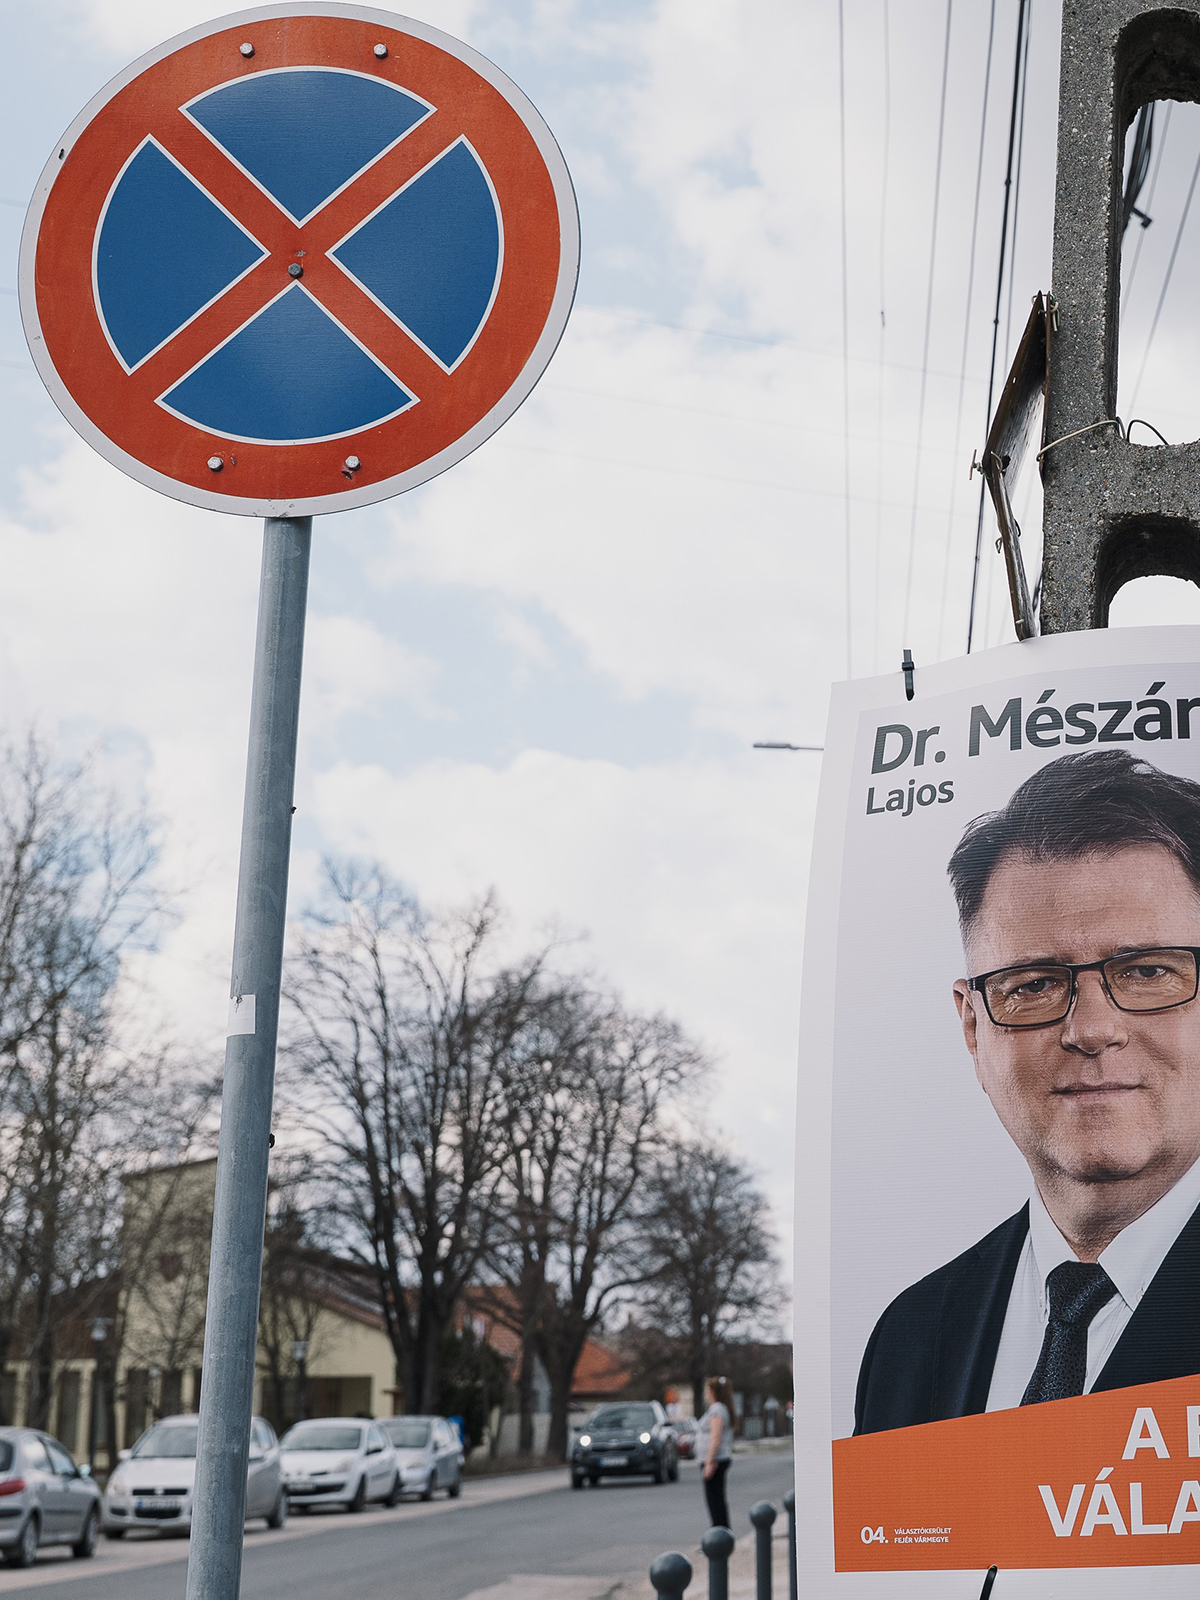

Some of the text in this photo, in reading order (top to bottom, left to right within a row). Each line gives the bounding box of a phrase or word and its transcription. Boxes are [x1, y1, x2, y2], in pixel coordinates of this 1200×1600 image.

[870, 722, 946, 775] Dr.
[866, 777, 955, 817] Lajos
[1121, 1407, 1170, 1460] A
[860, 1526, 889, 1545] 04.
[894, 1527, 952, 1535] VÁLASZTÓKERÜLET
[894, 1535, 949, 1544] FEJÉR VÁRMEGYE
